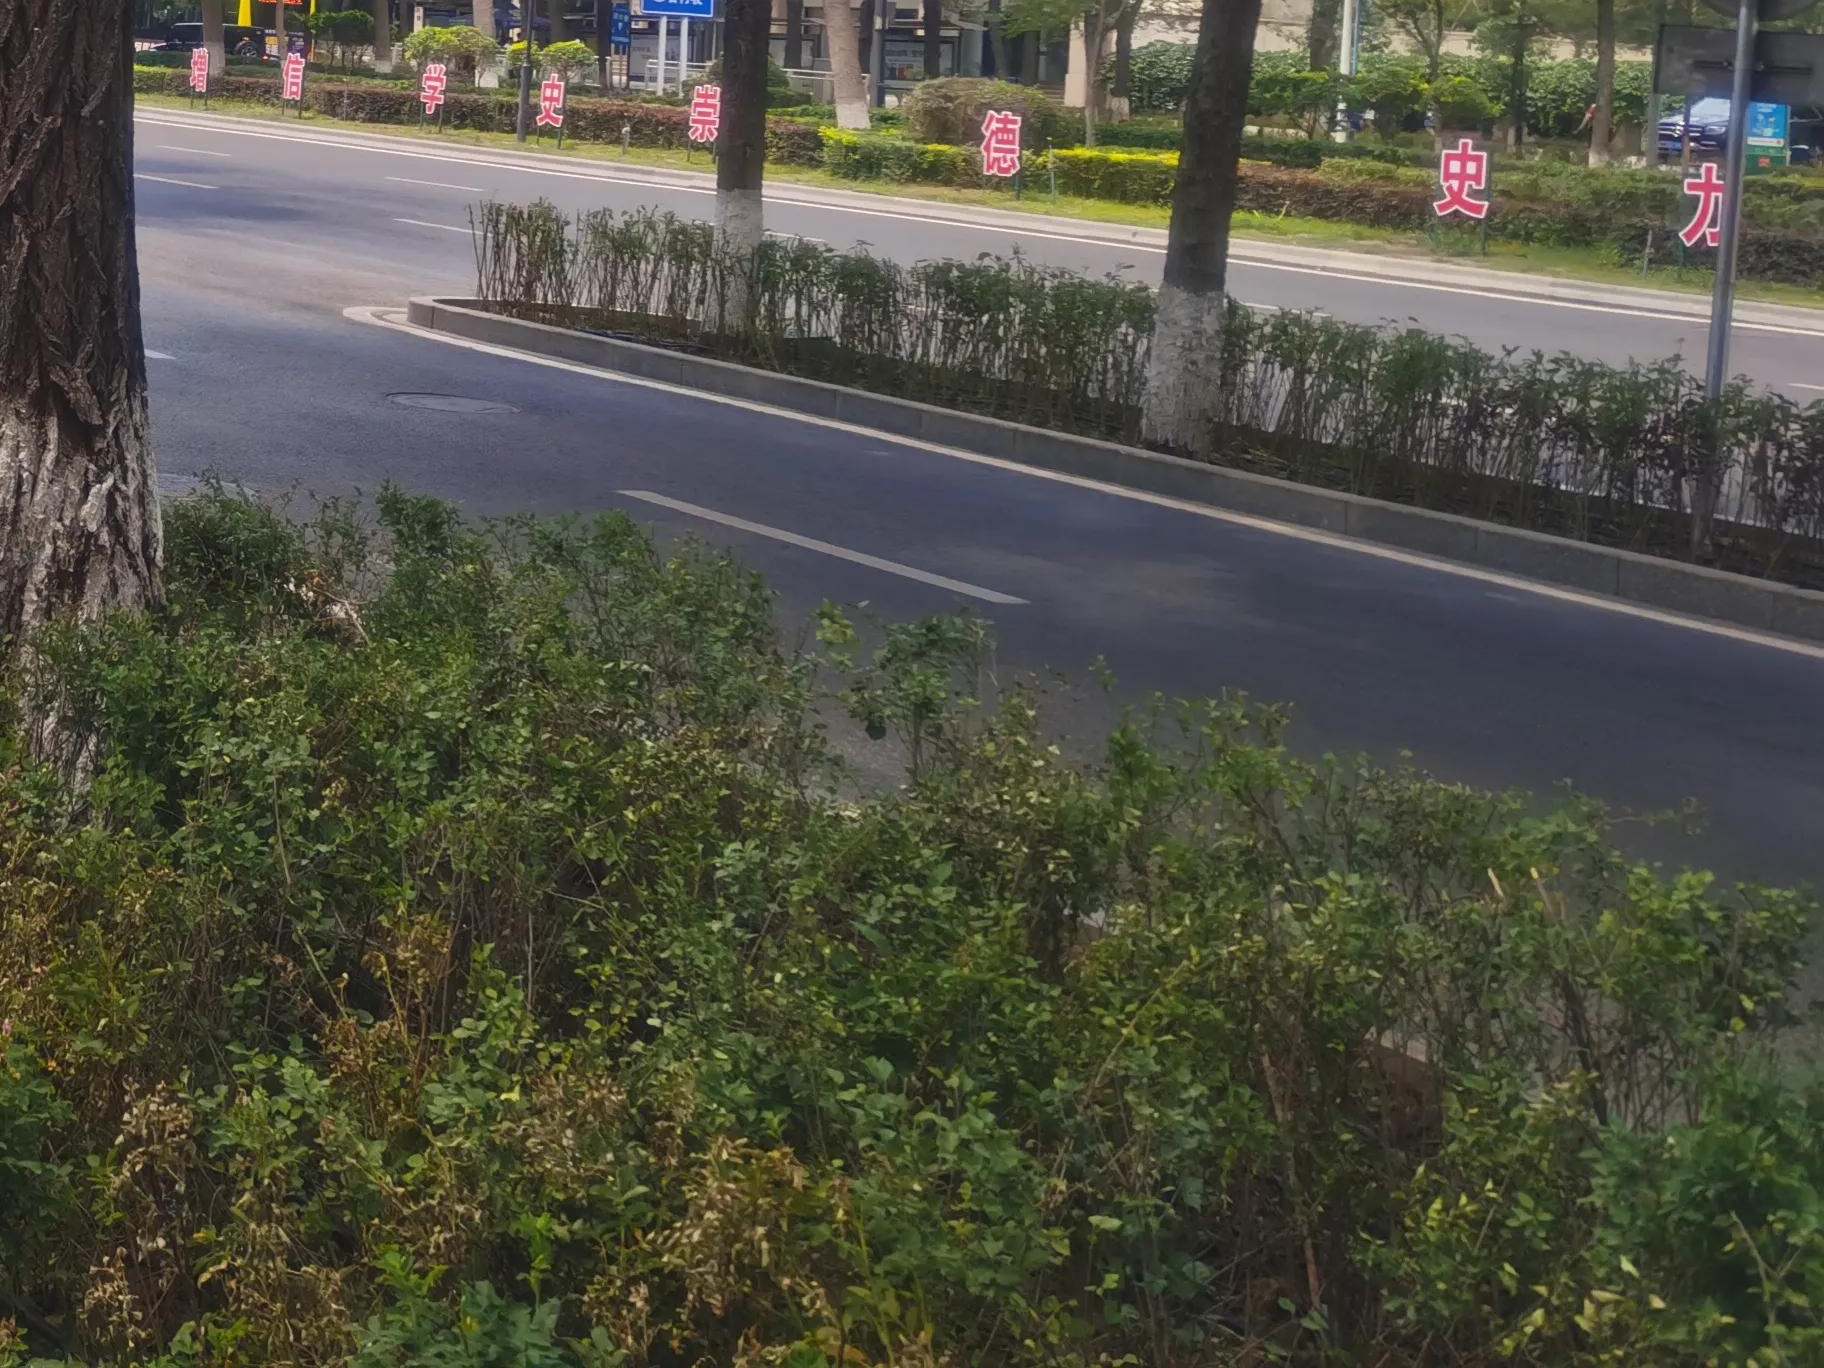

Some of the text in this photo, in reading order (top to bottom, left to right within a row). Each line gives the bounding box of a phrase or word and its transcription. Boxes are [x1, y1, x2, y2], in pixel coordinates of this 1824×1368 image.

[282, 52, 306, 101] 信
[420, 64, 1022, 177] 学 史 崇 德
[1433, 138, 1489, 219] 史
